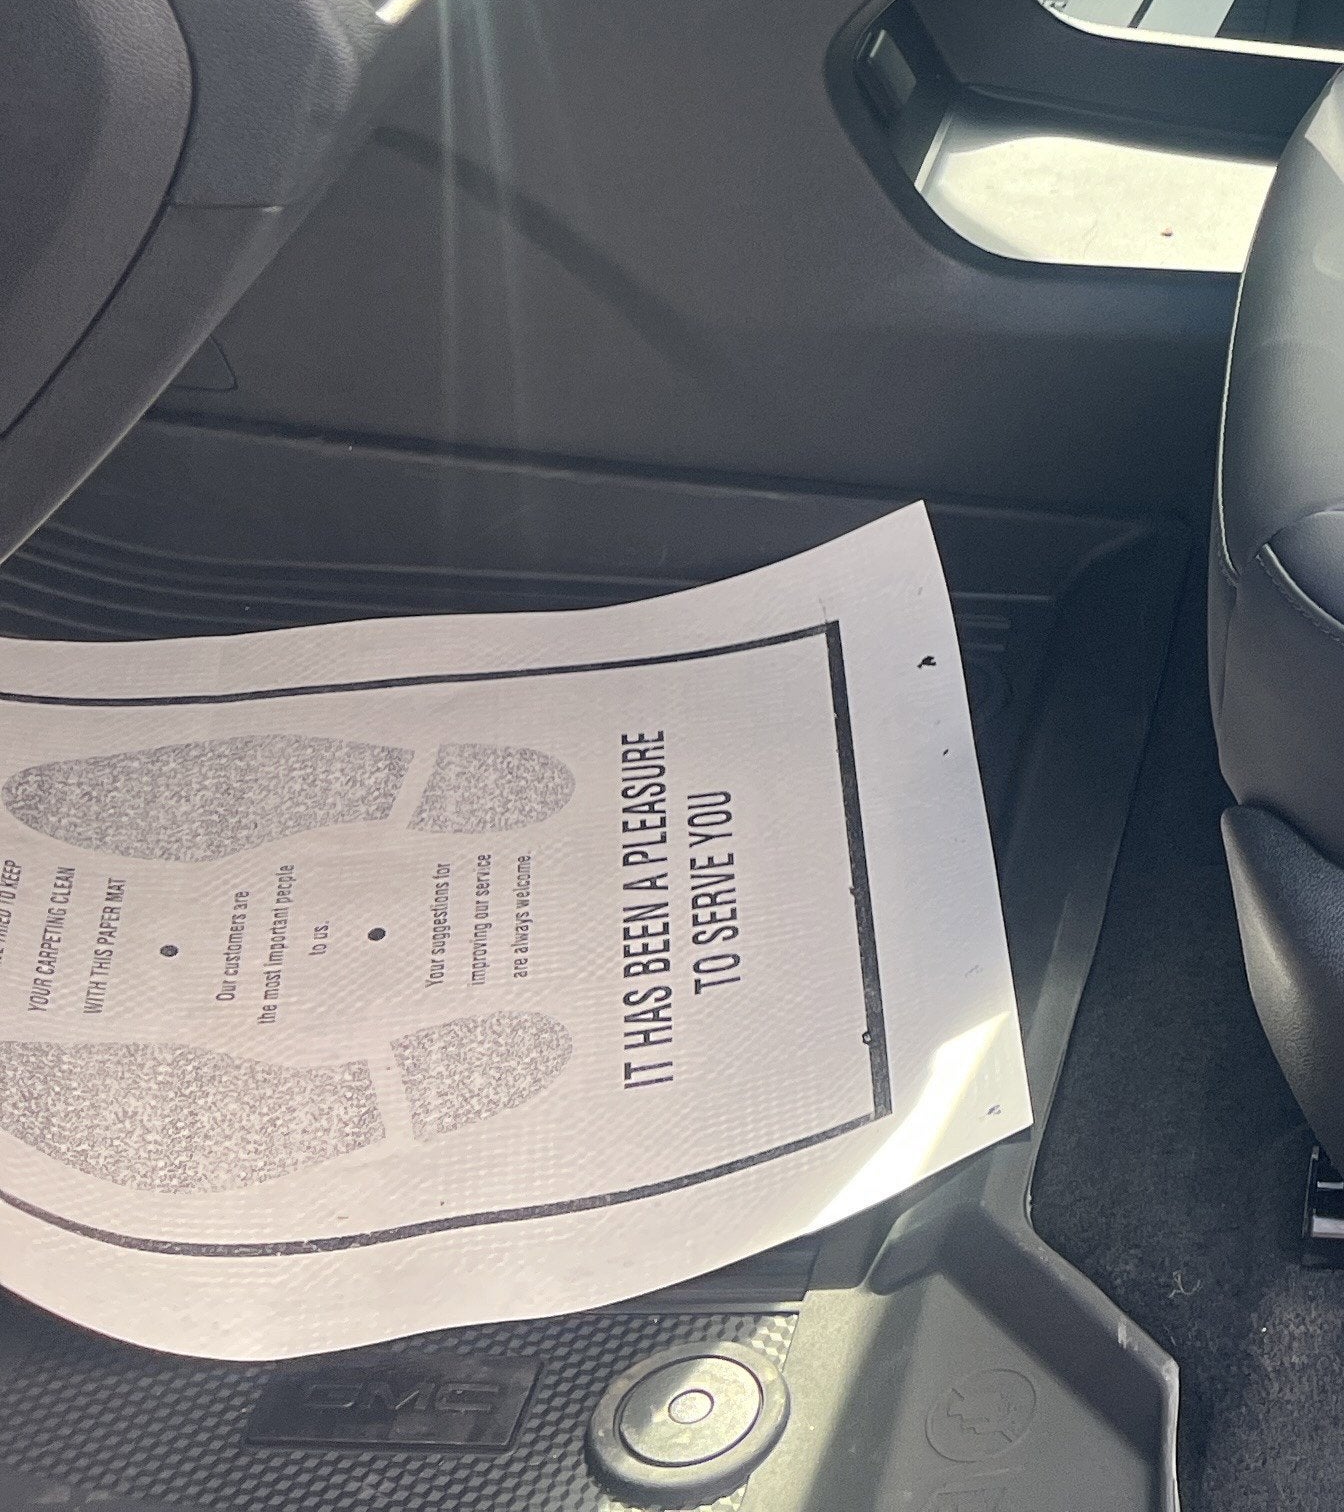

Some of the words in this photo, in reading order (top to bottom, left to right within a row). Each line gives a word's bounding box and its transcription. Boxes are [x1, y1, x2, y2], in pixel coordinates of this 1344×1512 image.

[621, 730, 668, 866] PLEASURE
[687, 791, 733, 849] YOU
[0, 859, 22, 889] KEEP
[50, 867, 75, 904] CLEAN
[432, 863, 451, 880] for
[623, 873, 669, 891] A
[105, 878, 126, 902] MAT
[232, 891, 249, 910] are
[689, 852, 739, 945] SERVE
[96, 906, 121, 945] PAPER
[428, 882, 451, 955] suggestions
[475, 900, 489, 919] our
[36, 908, 67, 975] CARPETING
[221, 914, 248, 976] customers
[263, 907, 290, 966] important
[313, 920, 329, 940] us.
[511, 911, 533, 954] always
[622, 902, 670, 978] BEEN
[90, 949, 113, 977] THIS
[308, 944, 327, 955] to
[469, 923, 492, 986] improving
[425, 959, 446, 988] Your
[511, 958, 528, 978] are
[693, 953, 741, 995] TO
[28, 978, 53, 1011] YOUR
[83, 981, 107, 1014] WITH
[215, 980, 237, 1001] Our
[262, 970, 282, 1000] most
[257, 1004, 278, 1024] the
[623, 986, 672, 1050] HAS
[624, 1062, 673, 1089] IT
